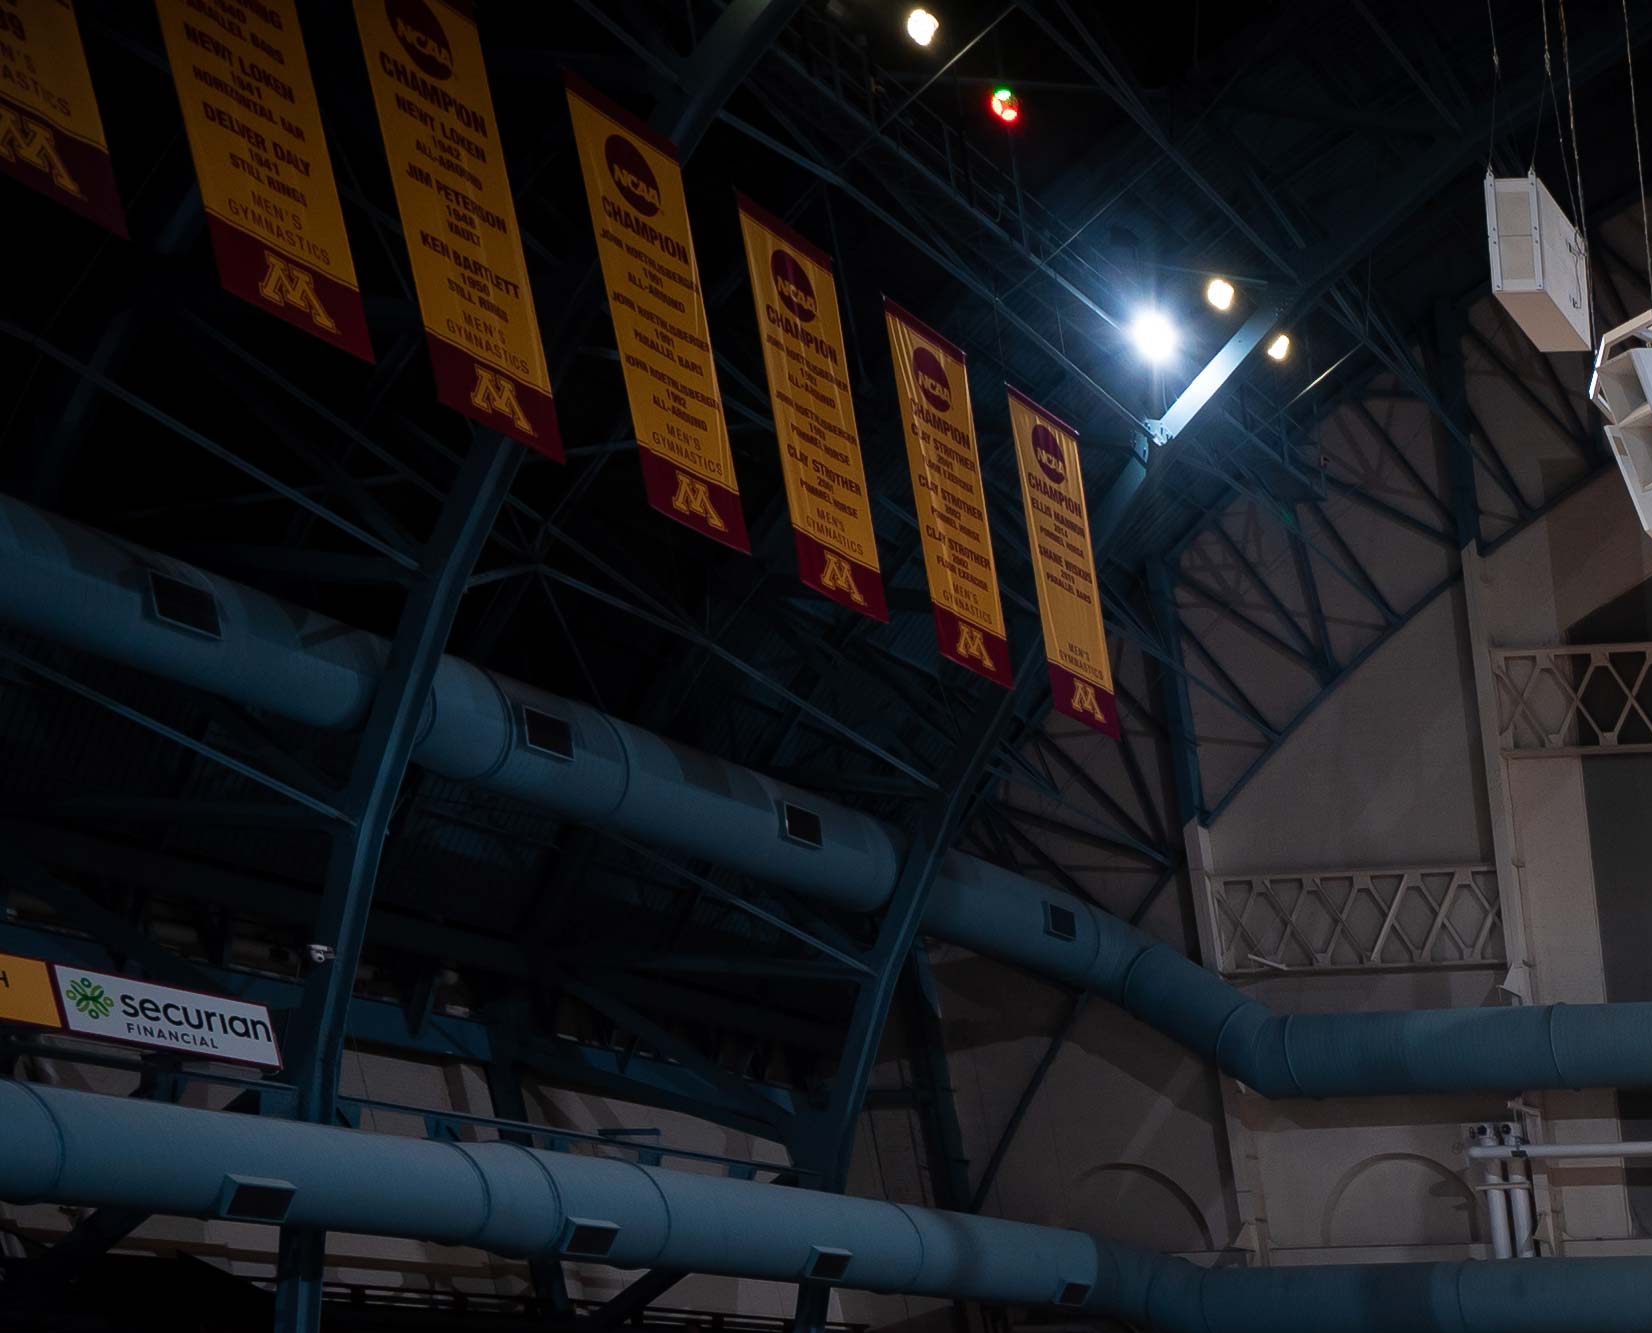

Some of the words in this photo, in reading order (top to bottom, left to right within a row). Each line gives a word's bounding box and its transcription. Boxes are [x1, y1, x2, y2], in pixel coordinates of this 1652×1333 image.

[379, 51, 488, 138] CHAMPION
[228, 199, 330, 266] GYMNASTICS
[601, 195, 688, 265] CHAMPION
[420, 231, 451, 263] KEN
[453, 252, 520, 300] BARTLETT
[446, 317, 530, 376] GYMNASTICS
[766, 304, 838, 365] CHAMPION
[652, 431, 723, 477] GYMNASTICS
[1027, 471, 1082, 519] CHAMPION
[120, 994, 272, 1042] securian
[126, 1022, 218, 1049] FINANCIAL
